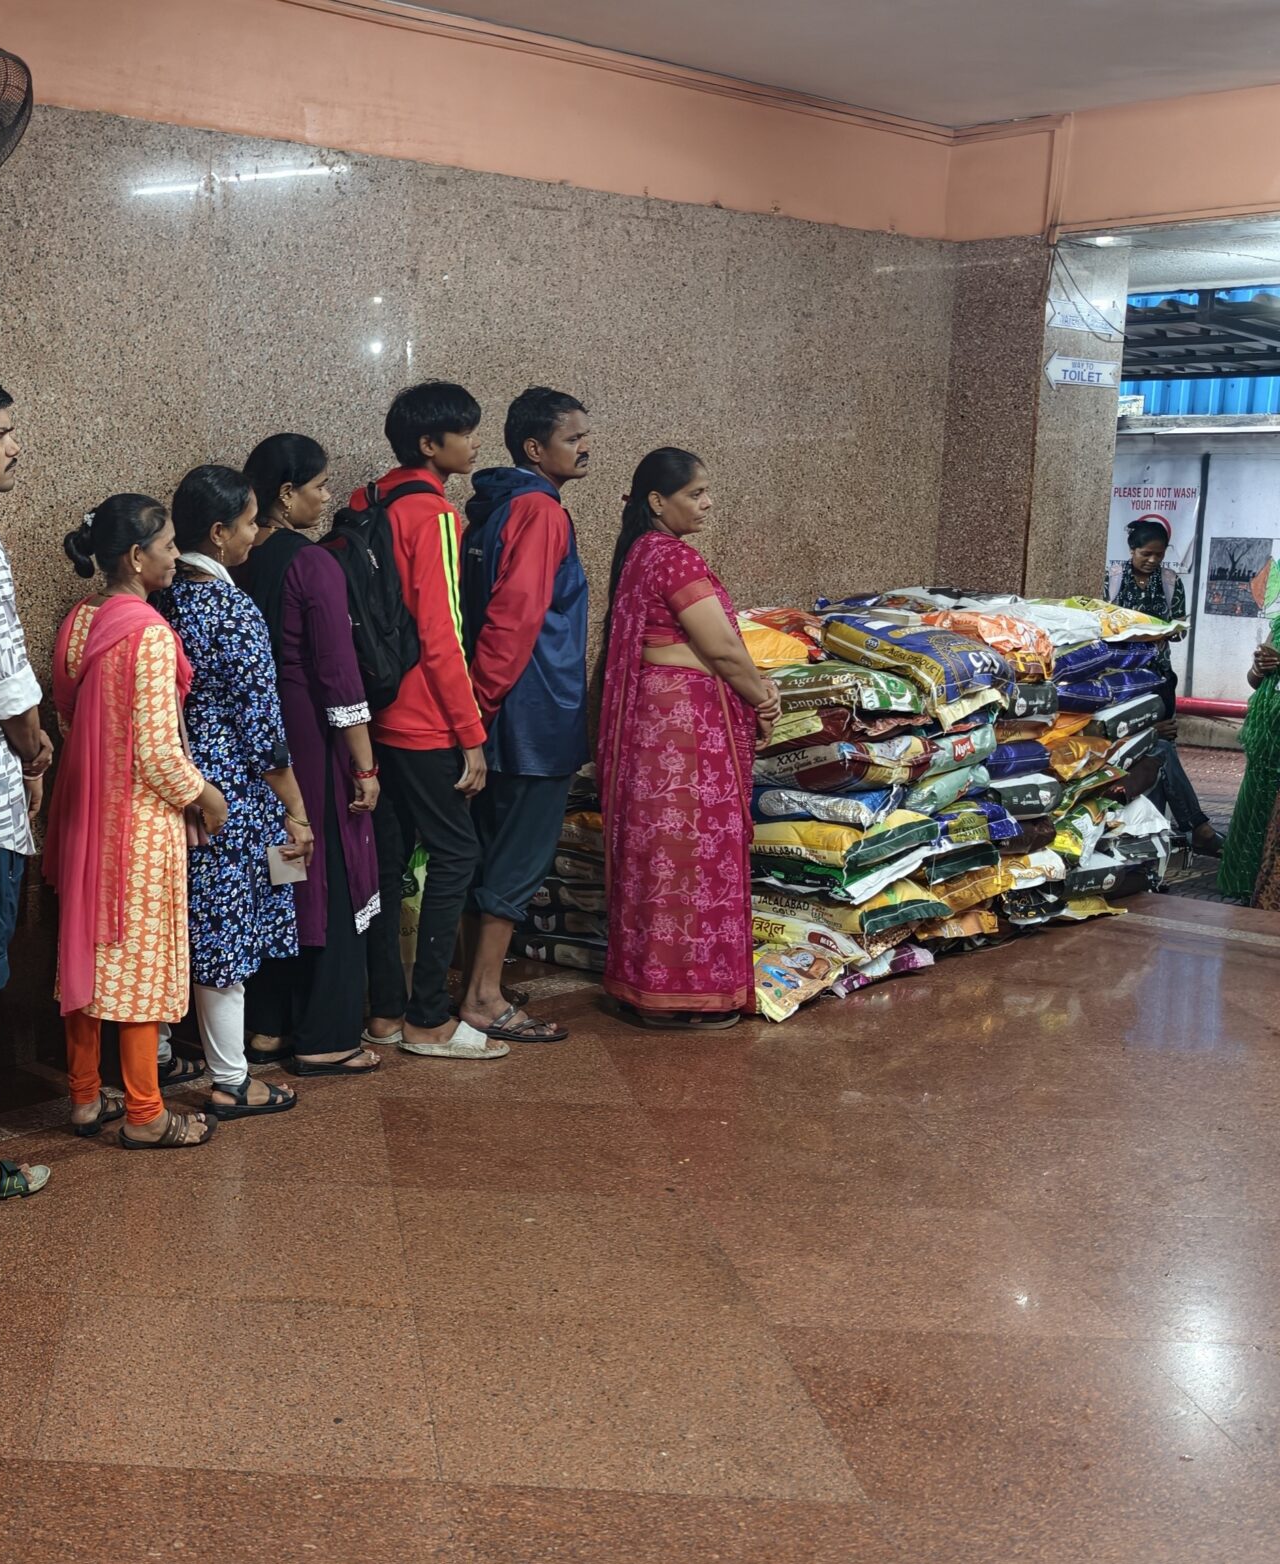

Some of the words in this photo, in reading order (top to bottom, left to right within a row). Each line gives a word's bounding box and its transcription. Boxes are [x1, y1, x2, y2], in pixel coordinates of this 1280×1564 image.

[1071, 361, 1084, 369] WAY
[1061, 369, 1102, 383] TOILET
[1114, 487, 1141, 498] PLEASE
[1143, 487, 1154, 497] DO
[1156, 487, 1172, 497] NOT
[1173, 487, 1197, 498] WASH
[1131, 500, 1152, 511] YOUR
[1153, 500, 1177, 511] TIFFIN
[758, 895, 810, 911] JALALABAD
[772, 906, 797, 917] GOLD
